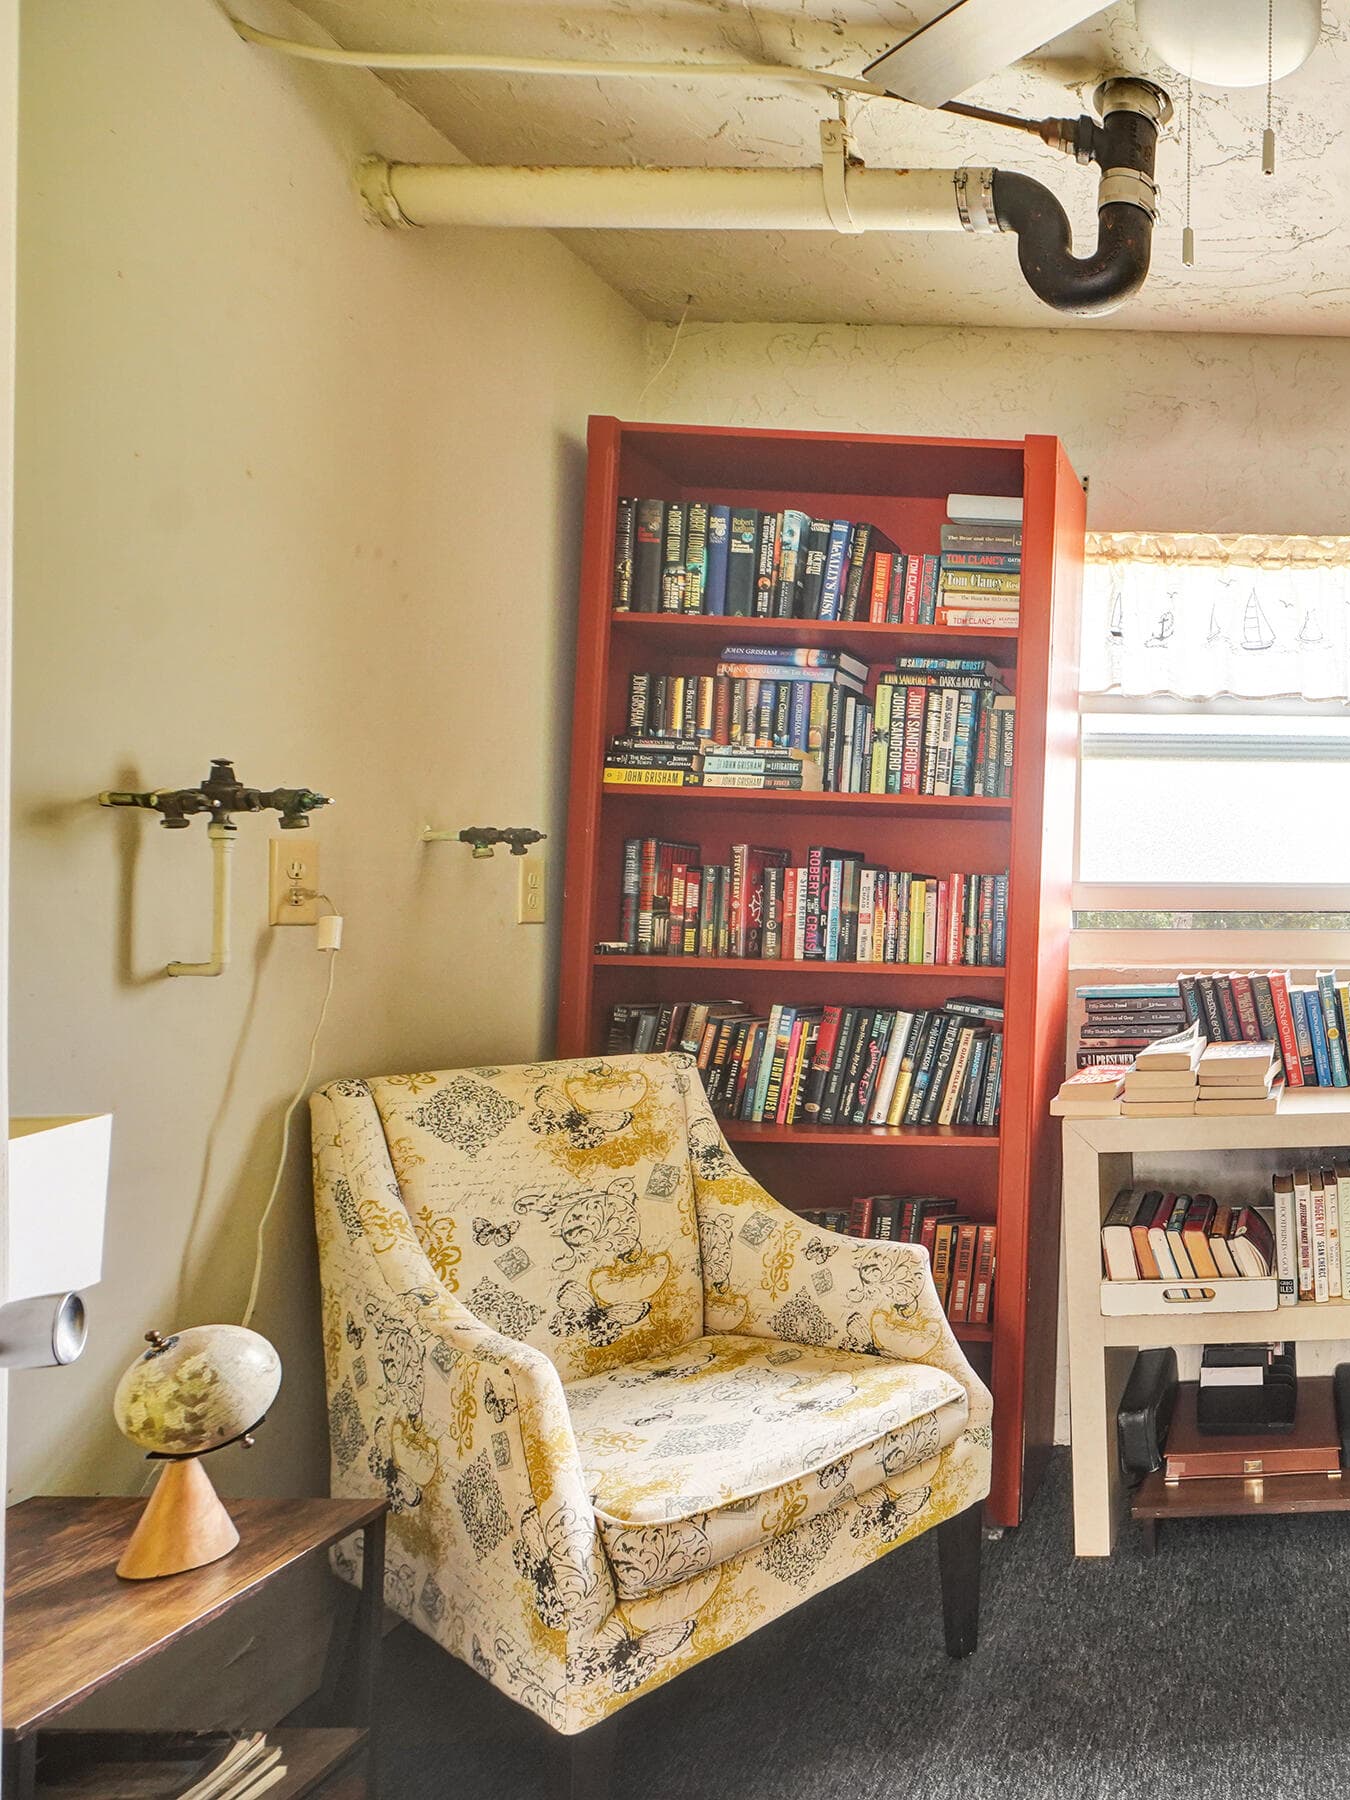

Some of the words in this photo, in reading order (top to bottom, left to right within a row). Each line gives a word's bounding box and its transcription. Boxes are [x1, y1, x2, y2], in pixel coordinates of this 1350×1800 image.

[946, 554, 965, 564] TOM
[967, 555, 1005, 565] CLANCY
[946, 573, 967, 585] Tom
[969, 573, 1002, 592] Clancy
[893, 693, 906, 719] JOHN
[907, 691, 921, 719] JOHN
[1004, 712, 1014, 731] JOHN
[889, 721, 904, 771] SANDFORD
[904, 720, 920, 771] SANDFORD
[1003, 732, 1013, 767] SANDFORD
[623, 771, 643, 782] JOHN
[644, 772, 679, 784] GRISHAM
[807, 850, 820, 896] ROBERT
[638, 912, 652, 943] MOTIVE
[805, 915, 818, 950] CRAIS
[770, 1057, 784, 1082] NIGHT
[765, 1084, 781, 1111] MOVES
